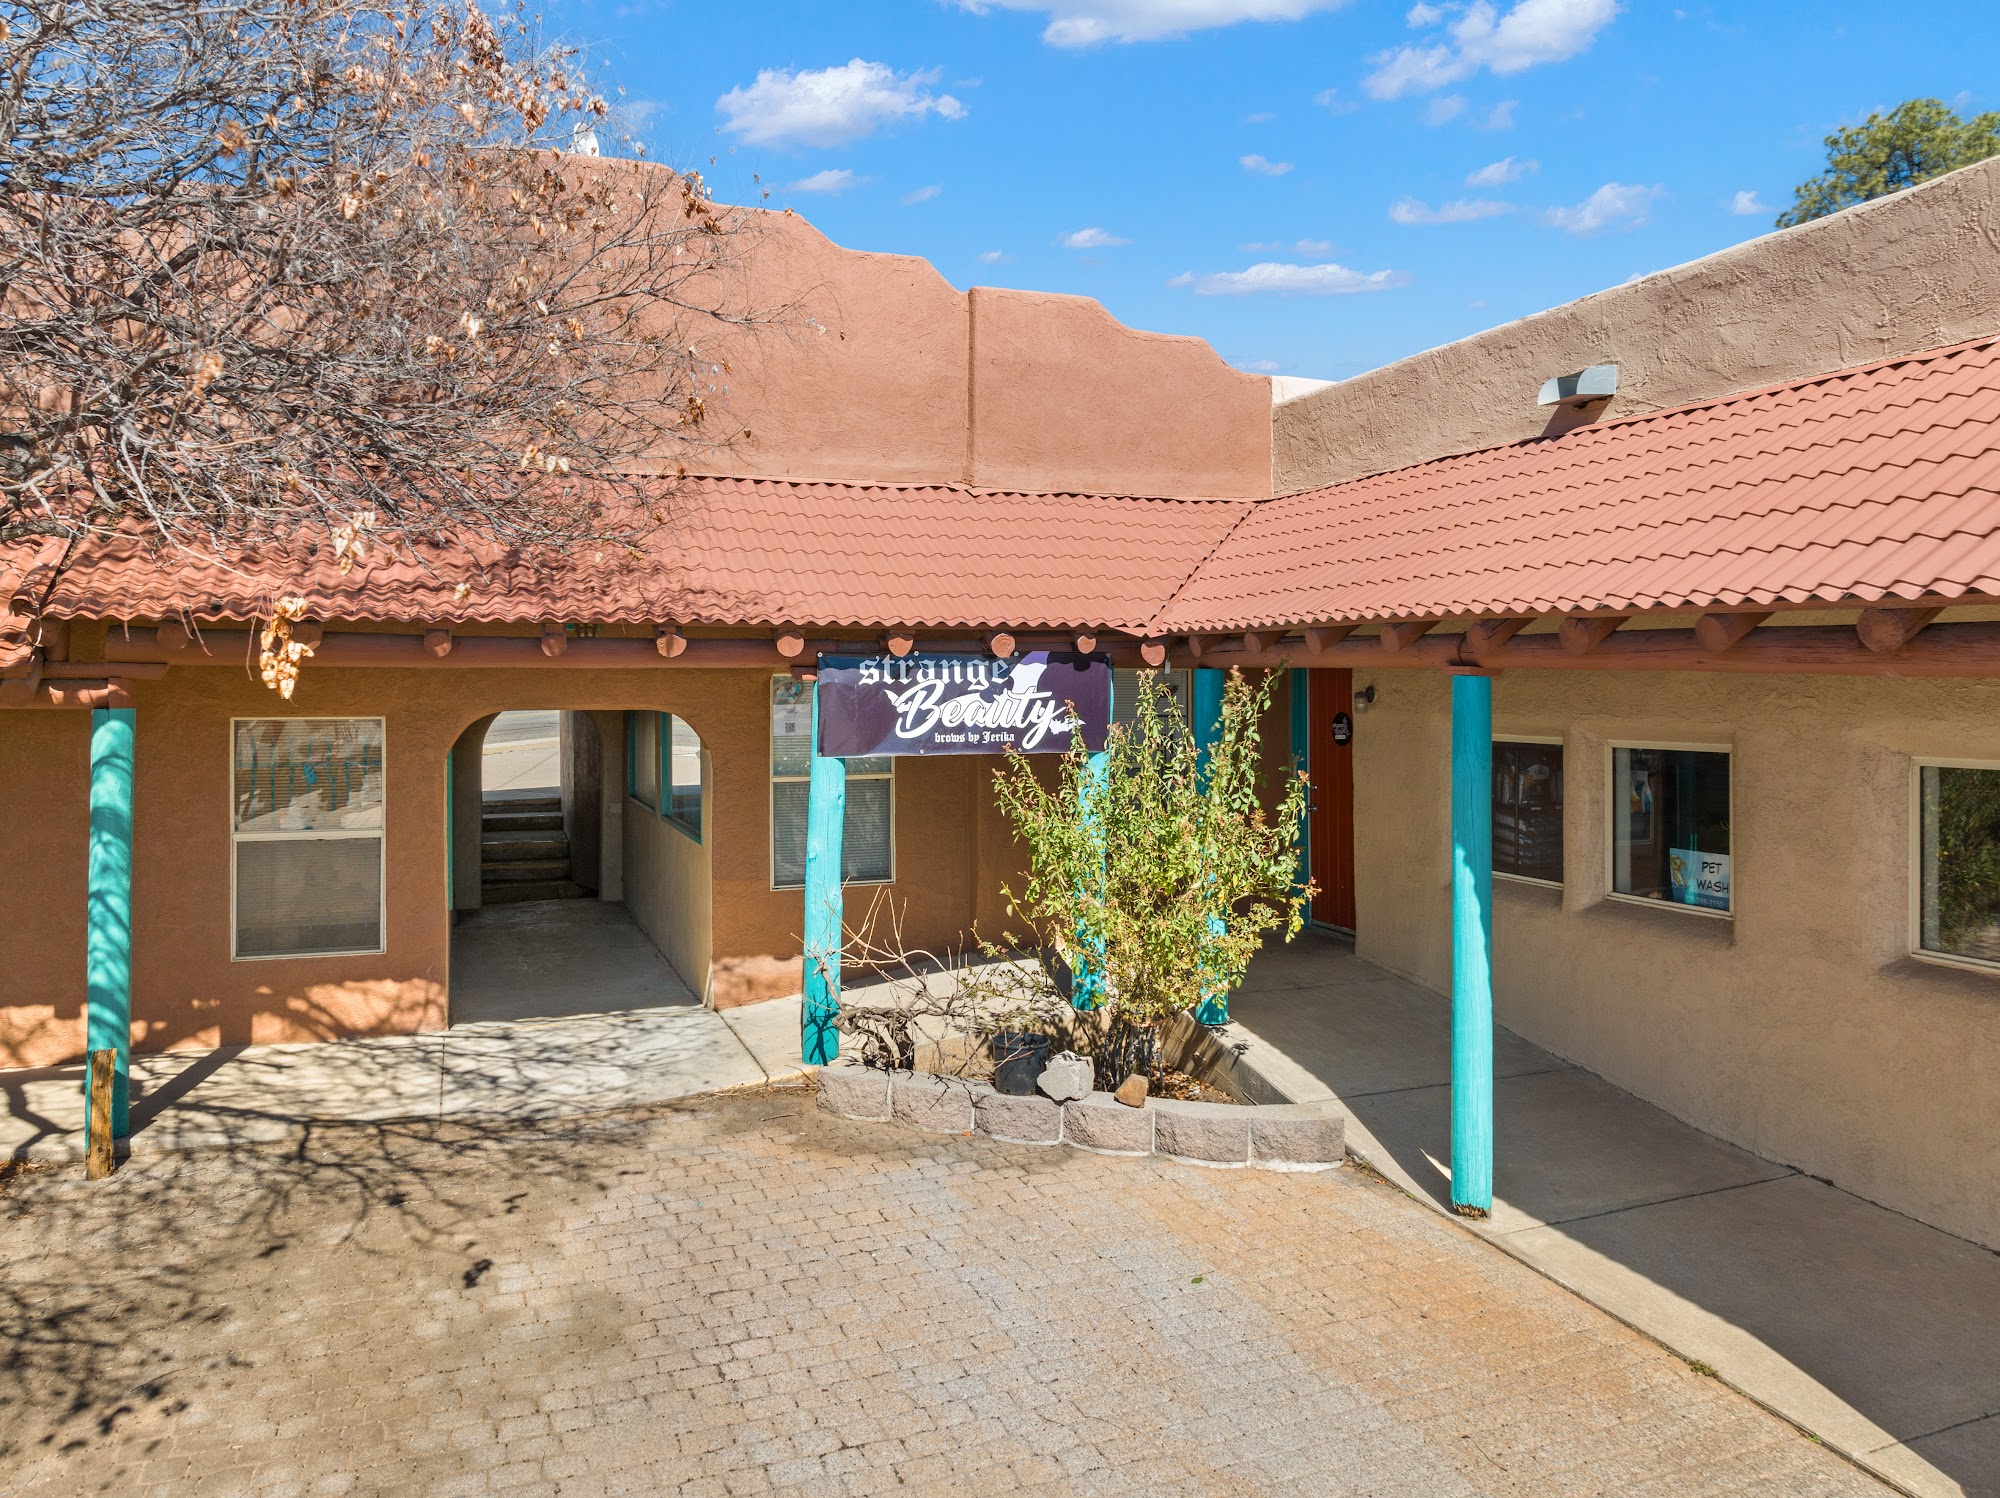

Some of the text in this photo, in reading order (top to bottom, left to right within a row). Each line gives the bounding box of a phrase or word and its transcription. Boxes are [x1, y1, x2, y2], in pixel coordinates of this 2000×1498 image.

[858, 654, 1010, 691] strange
[895, 678, 1066, 749] Beauty
[934, 732, 966, 743] brows
[968, 733, 980, 744] by
[1701, 861, 1722, 875] PET
[1696, 878, 1729, 894] WASH
